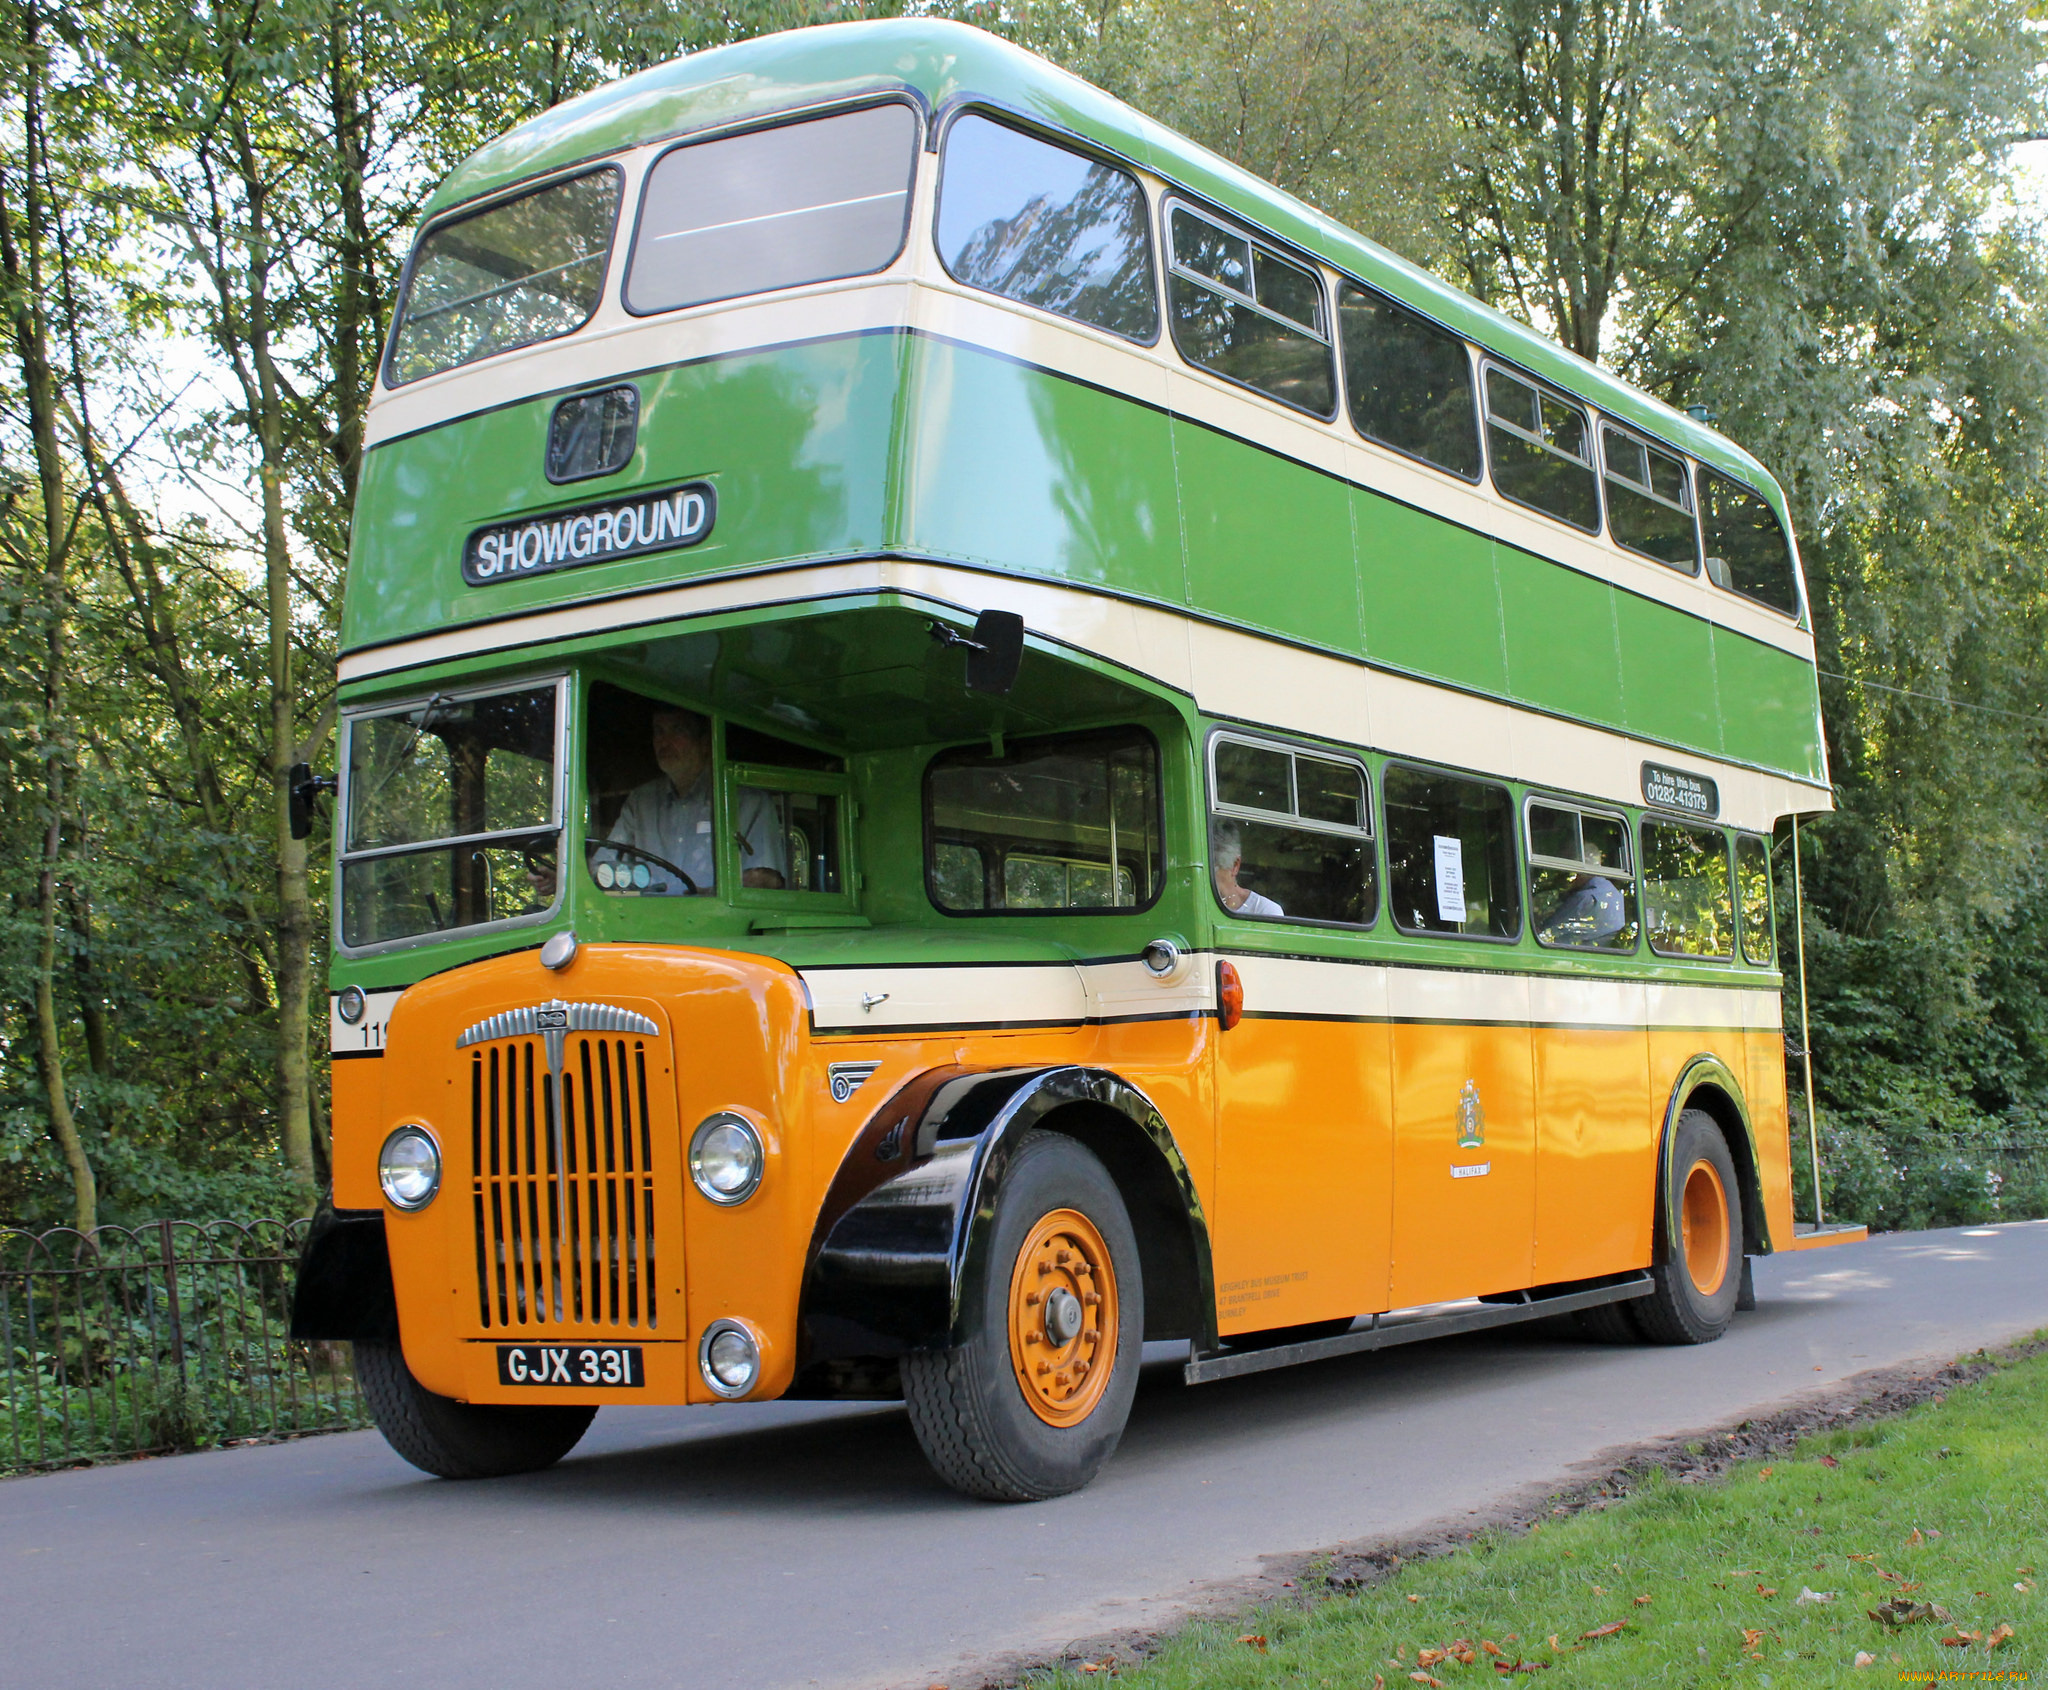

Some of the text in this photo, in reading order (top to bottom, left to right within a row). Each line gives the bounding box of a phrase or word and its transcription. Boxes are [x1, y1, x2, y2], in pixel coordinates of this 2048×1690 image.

[476, 493, 706, 578] SHOWGROUND
[1652, 770, 1701, 793] To hire this bus
[1647, 782, 1708, 811] 01282-413179
[1264, 1274, 1290, 1286] MUSEUM
[1291, 1271, 1309, 1282] TRUST
[508, 1348, 632, 1385] GJX 331
